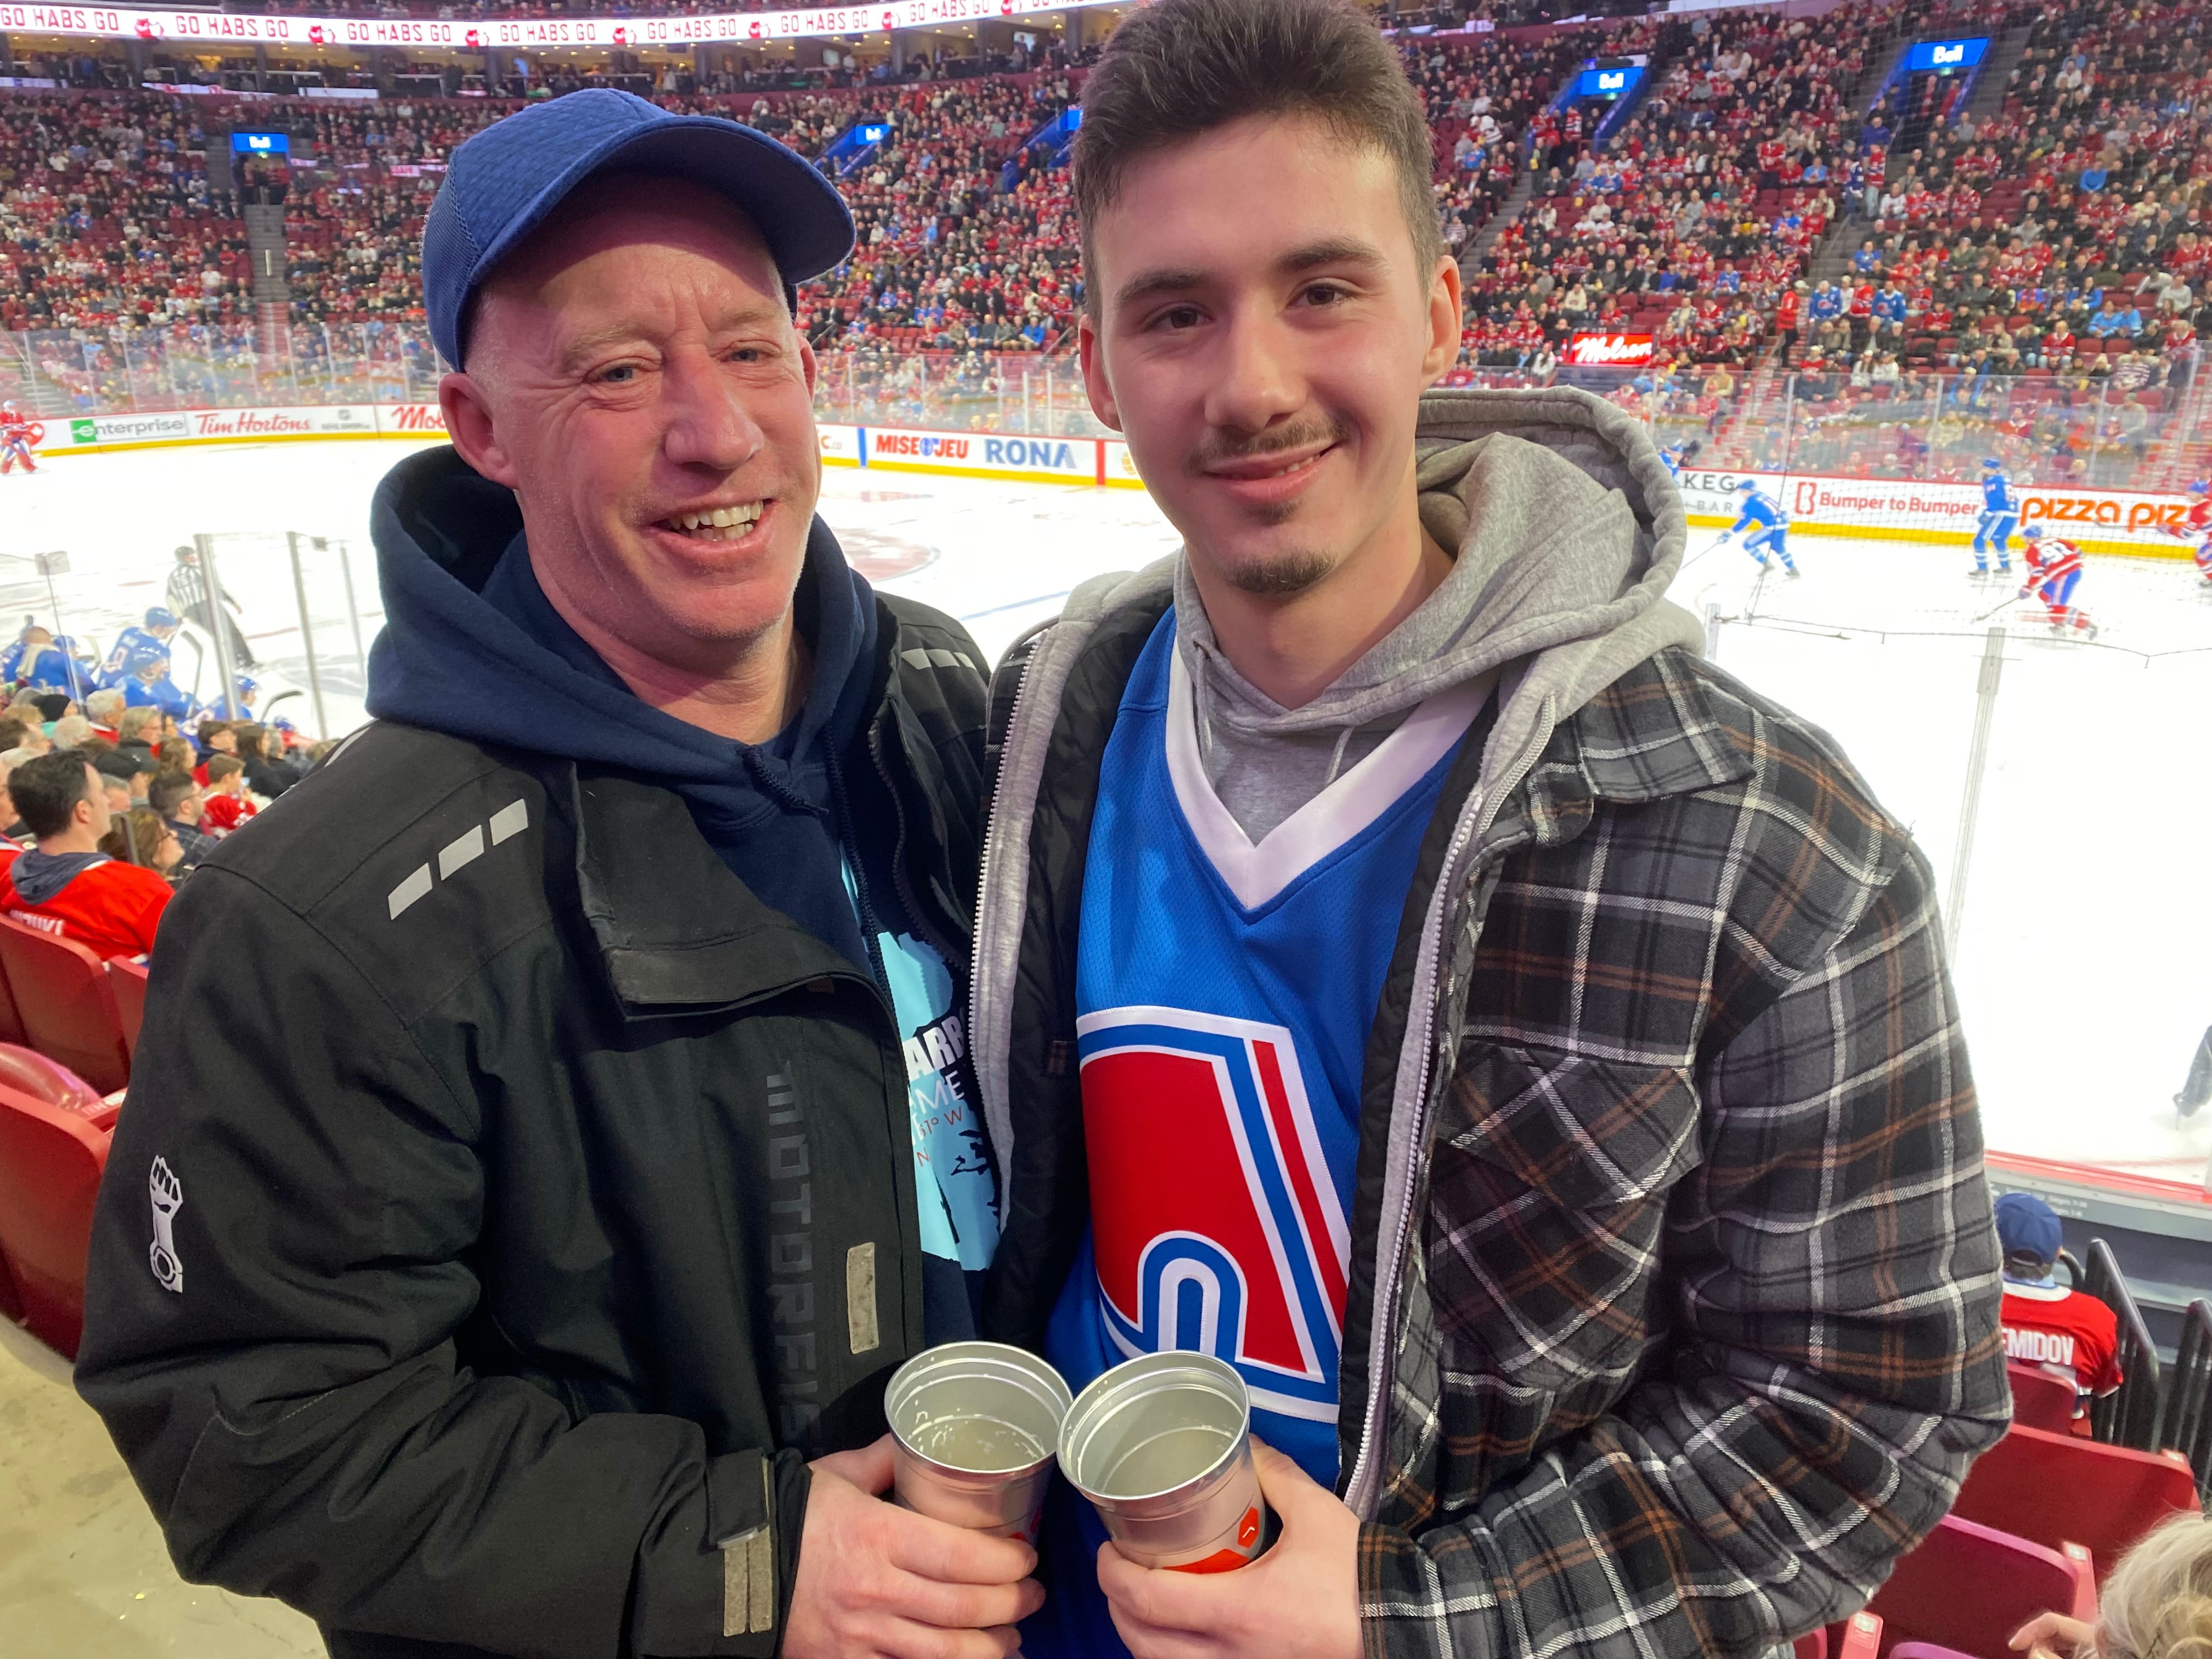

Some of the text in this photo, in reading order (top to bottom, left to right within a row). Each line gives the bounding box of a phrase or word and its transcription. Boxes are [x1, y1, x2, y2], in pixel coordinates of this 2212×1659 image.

[1, 7, 119, 31] GO HABS GO
[781, 9, 868, 33] GO HABS GO
[909, 0, 989, 22] GO HABS GO
[176, 15, 289, 38] GO HABS GO
[347, 22, 452, 42] GO HABS GO
[500, 23, 596, 42] GO HABS GO
[647, 18, 736, 40] GO HABS GO
[1933, 44, 1964, 64] Bell
[1572, 336, 1652, 363] Molson
[71, 419, 184, 438] enterprise
[195, 411, 311, 435] Tim Hortons
[985, 438, 1077, 469] RONA
[1684, 472, 1735, 492] KEG
[1697, 499, 1733, 513] BAR
[1820, 492, 1979, 516] Bumper to Bumper
[2019, 496, 2191, 533] pizza piz
